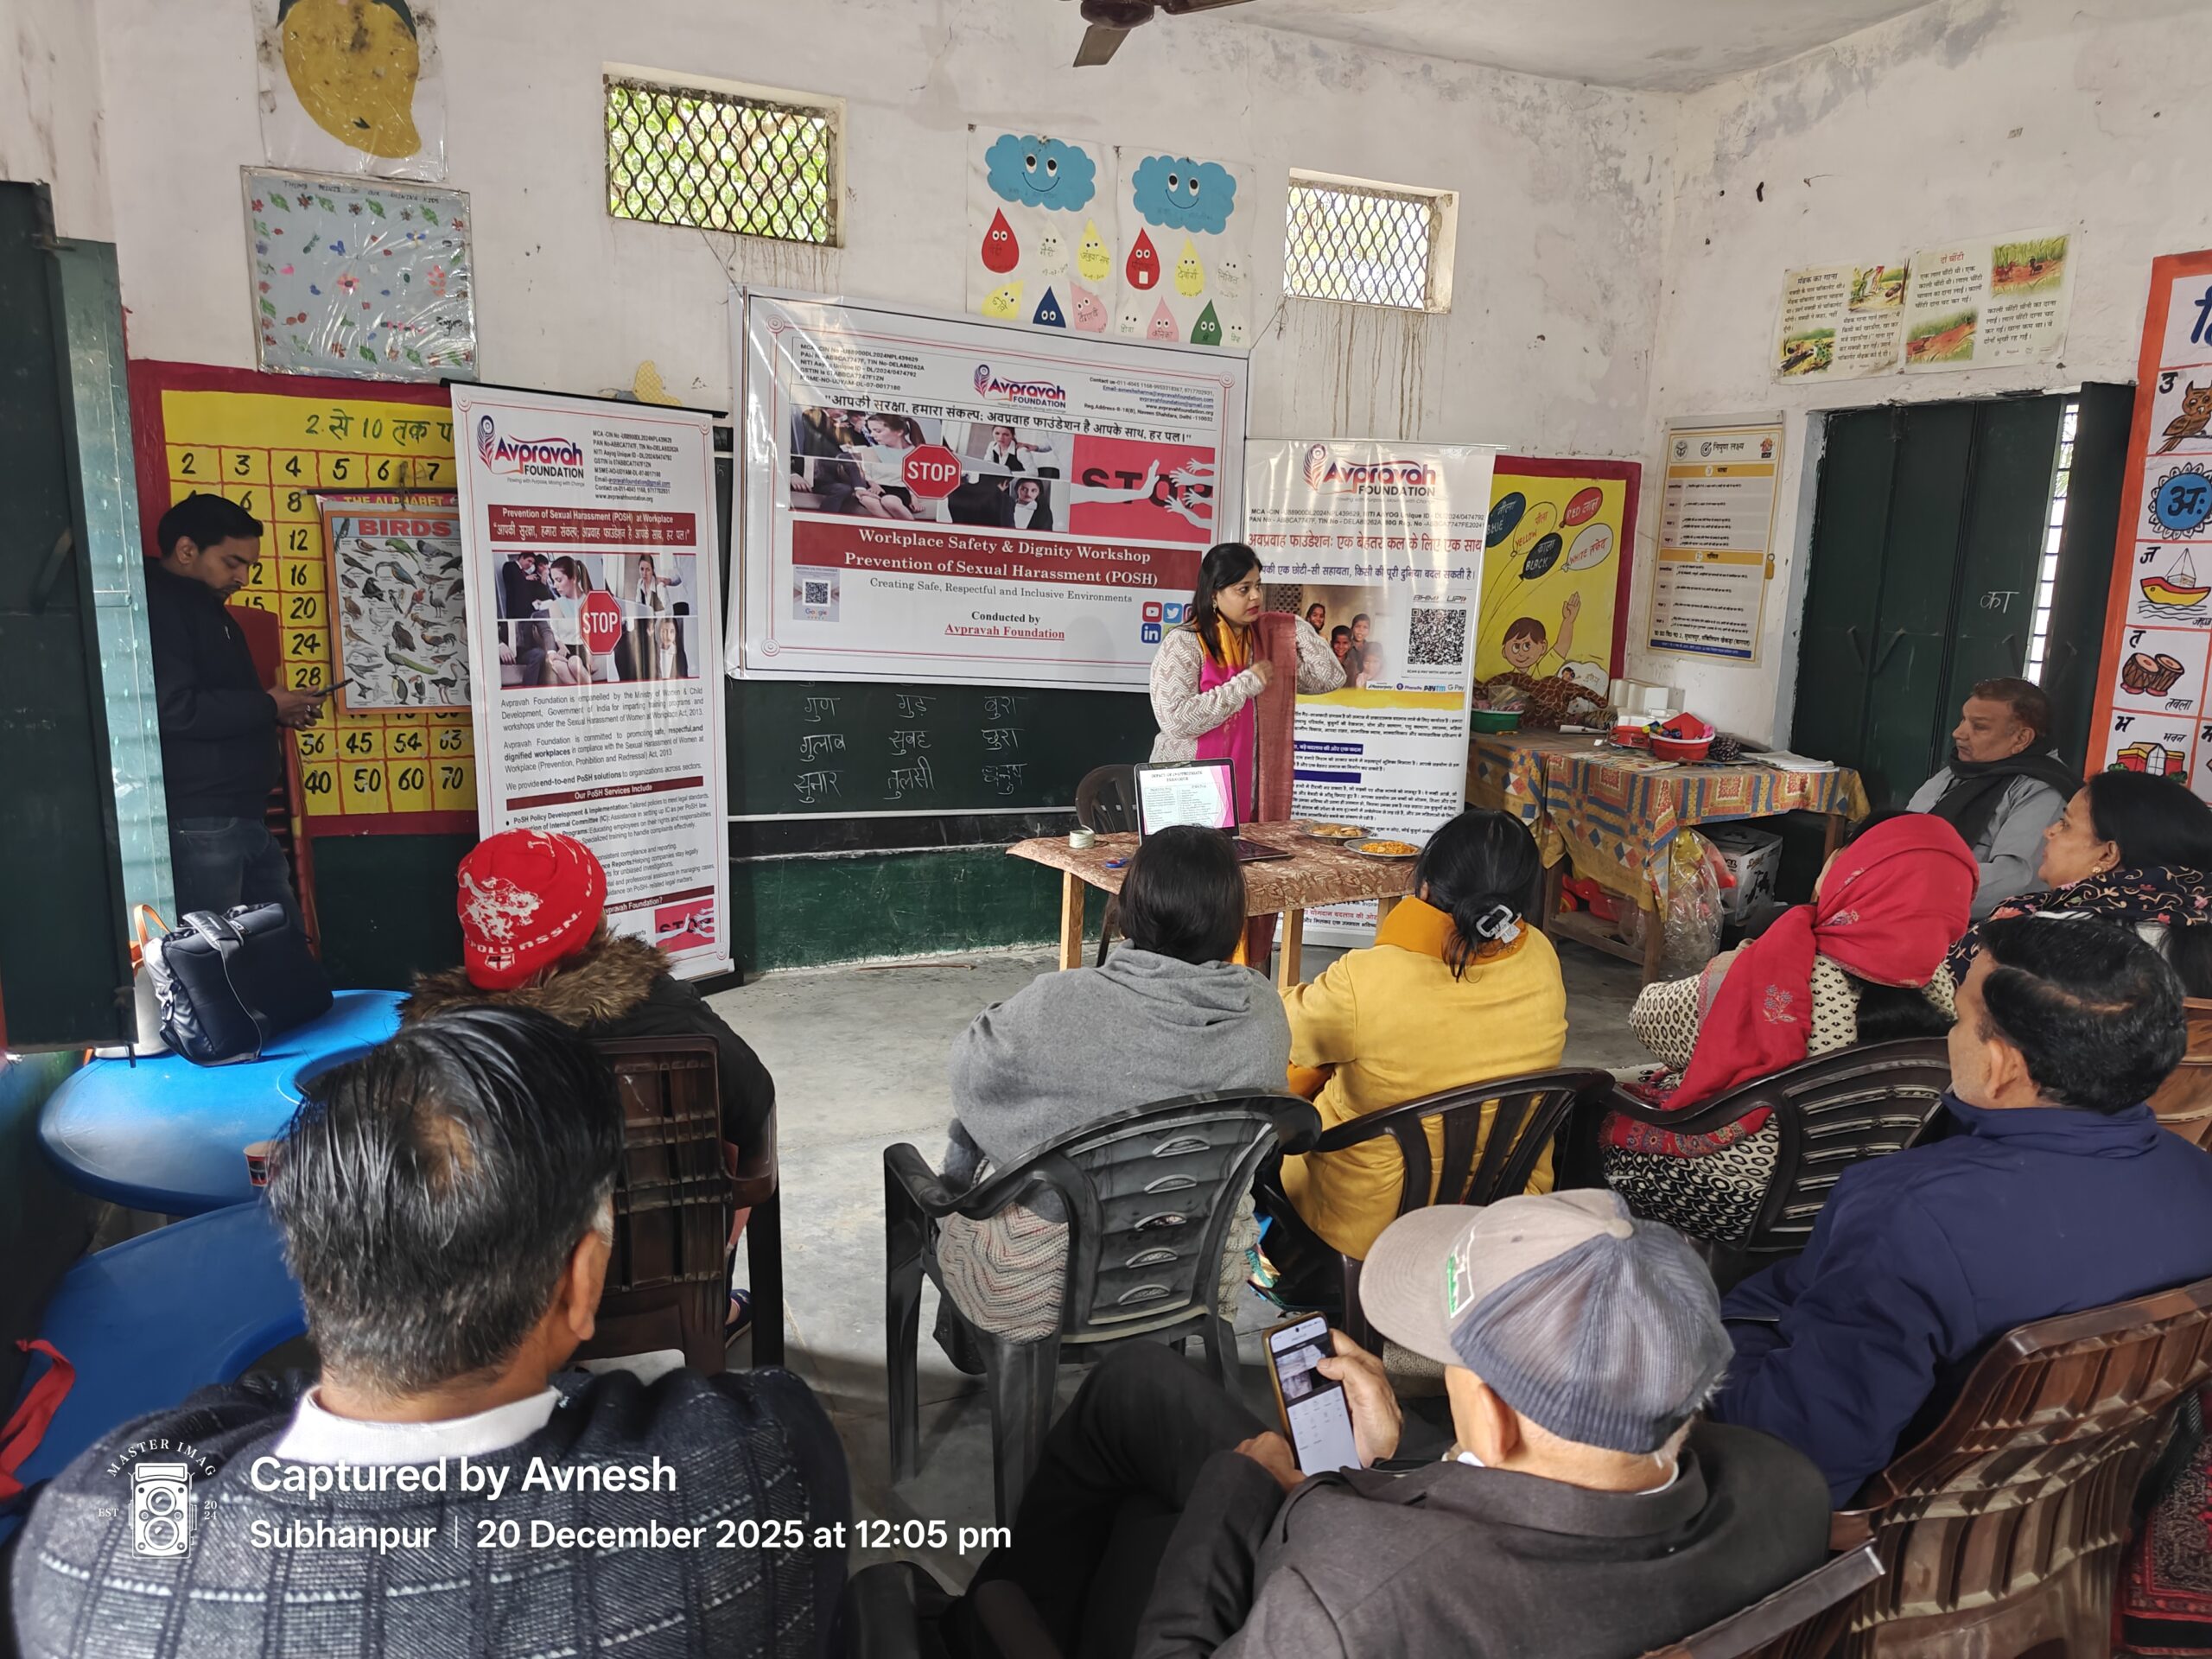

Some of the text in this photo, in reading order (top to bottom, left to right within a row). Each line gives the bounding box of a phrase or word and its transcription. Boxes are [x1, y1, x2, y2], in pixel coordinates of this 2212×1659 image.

[988, 378, 1065, 401] Avpravah
[2158, 371, 2179, 394] उ
[1013, 396, 1066, 408] FOUNDATION
[306, 414, 320, 435] 2
[329, 408, 355, 441] से
[362, 417, 383, 439] 10
[392, 419, 430, 446] तक
[912, 404, 943, 416] हमारा
[987, 411, 1030, 427] अवप्रवाह
[1033, 415, 1080, 432] फाउंडेशन
[1084, 418, 1091, 434] है
[1094, 423, 1122, 435] आपके
[1149, 430, 1163, 441] हर
[181, 453, 196, 475] 2
[235, 454, 251, 475] 3
[494, 436, 582, 474] Avpravah
[285, 456, 302, 477] 4
[332, 458, 350, 480] 5
[377, 460, 391, 480] 6
[427, 463, 441, 481] 7
[524, 465, 584, 479] FOUNDATION
[907, 461, 956, 483] STOP
[1323, 462, 1436, 494] Avpravah
[239, 491, 252, 512] 6
[1358, 486, 1436, 497] FOUNDATION
[2167, 484, 2207, 517] अः
[287, 493, 302, 512] 8
[1566, 507, 1580, 518] RED
[503, 508, 674, 524] Prevention of Sexual Harassment (POSH) Workplace
[358, 518, 453, 537] BIRDS
[1486, 520, 1503, 536] BLUE
[1516, 529, 1538, 547] YELLOW
[290, 529, 308, 551] 12
[859, 529, 1151, 564] Workplace Safety & Dignity Workshop
[1248, 533, 1287, 548] अवप्रवाह
[1337, 535, 1353, 550] एक
[1357, 531, 1383, 551] बेहतर
[1386, 537, 1405, 551] कल
[1408, 532, 1419, 550] के
[1444, 539, 1461, 553] एक
[1538, 539, 1557, 553] काला
[1526, 559, 1548, 571] BLACK
[1569, 549, 1588, 565] WHITE
[2139, 546, 2162, 564] ज
[290, 563, 308, 587] 16
[845, 551, 1158, 588] Prevention of Sexual Harassment (POSH)
[1278, 565, 1289, 575] एक
[1375, 563, 1383, 577] की
[1386, 565, 1399, 581] पूरी
[870, 577, 1133, 603] Creating Safe, Respectful and Inclusive Environments
[290, 596, 316, 620] 20
[1981, 591, 2018, 613] का
[582, 612, 619, 633] STOP
[971, 610, 1041, 626] Conducted by
[945, 623, 1065, 639] Avpravah Foundation
[2129, 630, 2146, 648] त
[292, 632, 321, 655] 24
[296, 667, 321, 688] 28
[501, 696, 568, 709] Avpravah Foundation
[804, 694, 1028, 722] गुण गुड़ बुरा
[2115, 715, 2135, 733] भ
[301, 733, 325, 755] 36
[346, 732, 373, 753] 45
[394, 733, 422, 753] 54
[439, 729, 461, 750] 63
[504, 736, 570, 750] Avpravah Foundation
[800, 728, 1025, 762] गुलाब सुबह छुरा
[505, 748, 570, 762] dignified workplaces
[398, 767, 425, 790] 60
[441, 767, 463, 790] 70
[505, 763, 537, 773] Workplace
[304, 769, 332, 795] 40
[354, 769, 381, 793] 50
[540, 774, 593, 787] end-to-end PoSH
[793, 755, 937, 804] सुनार तुलसी
[588, 784, 653, 798] PoSH Services Include
